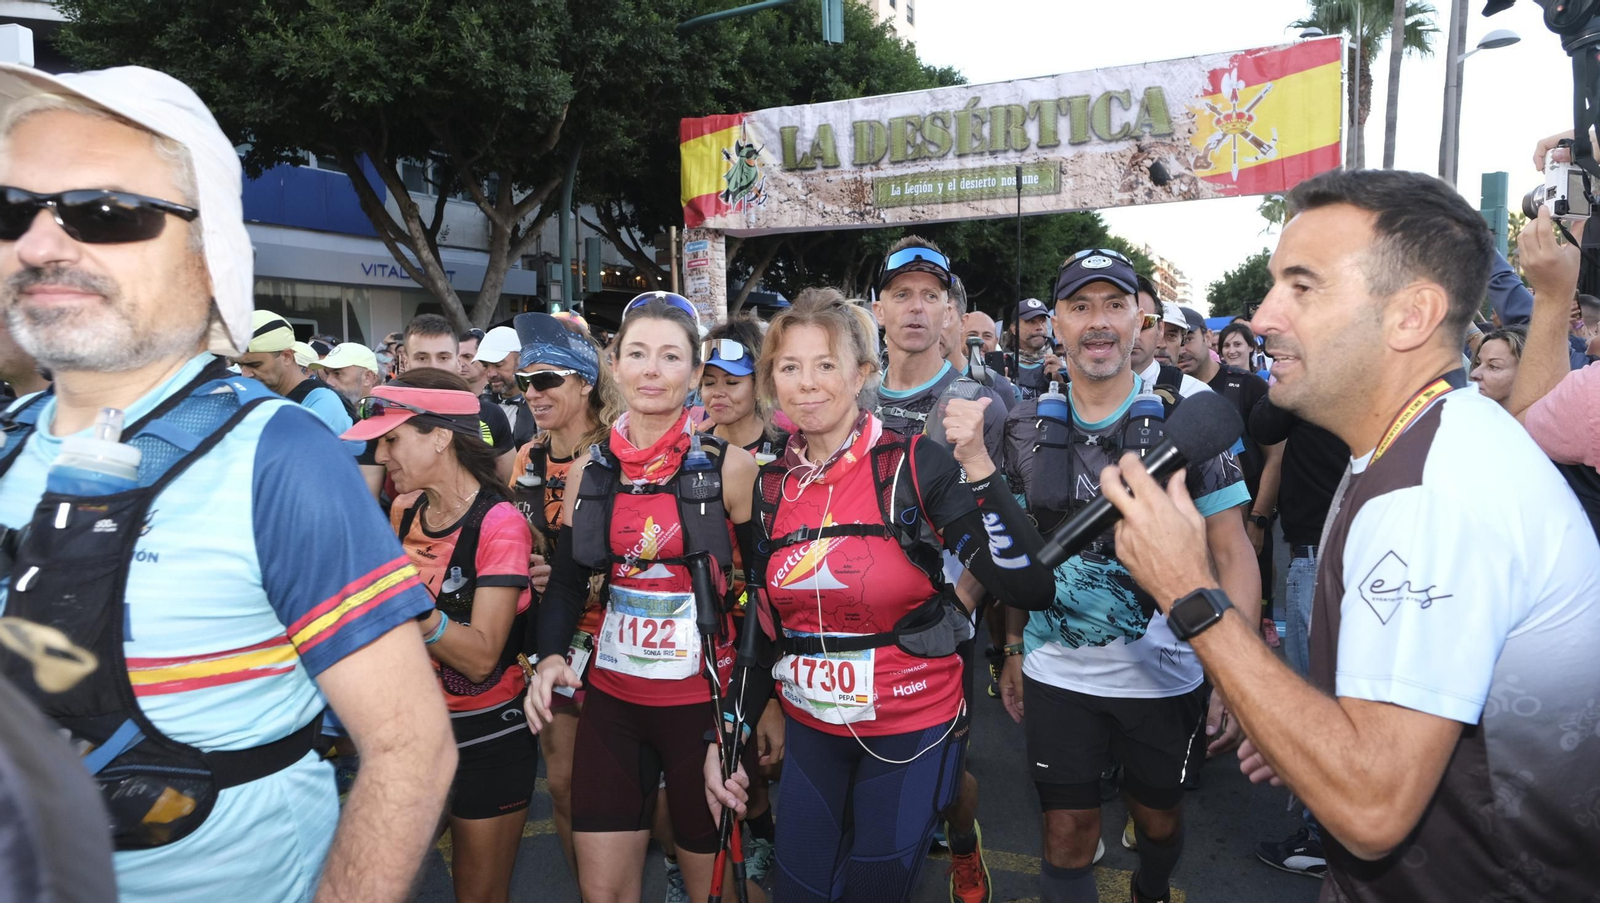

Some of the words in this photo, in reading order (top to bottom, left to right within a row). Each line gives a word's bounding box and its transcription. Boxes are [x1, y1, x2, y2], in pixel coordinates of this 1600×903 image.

[780, 124, 841, 171] LA
[852, 86, 1175, 166] DESÉRTICA
[891, 184, 901, 197] La
[904, 181, 934, 197] Legión
[937, 182, 944, 194] y
[947, 178, 956, 191] el
[960, 176, 997, 190] desierto
[1001, 176, 1017, 187] nos
[618, 614, 677, 649] 1122
[643, 649, 661, 657] SONIA
[663, 649, 675, 657] IRIS
[789, 656, 856, 694] 1730
[893, 680, 928, 698] Haier
